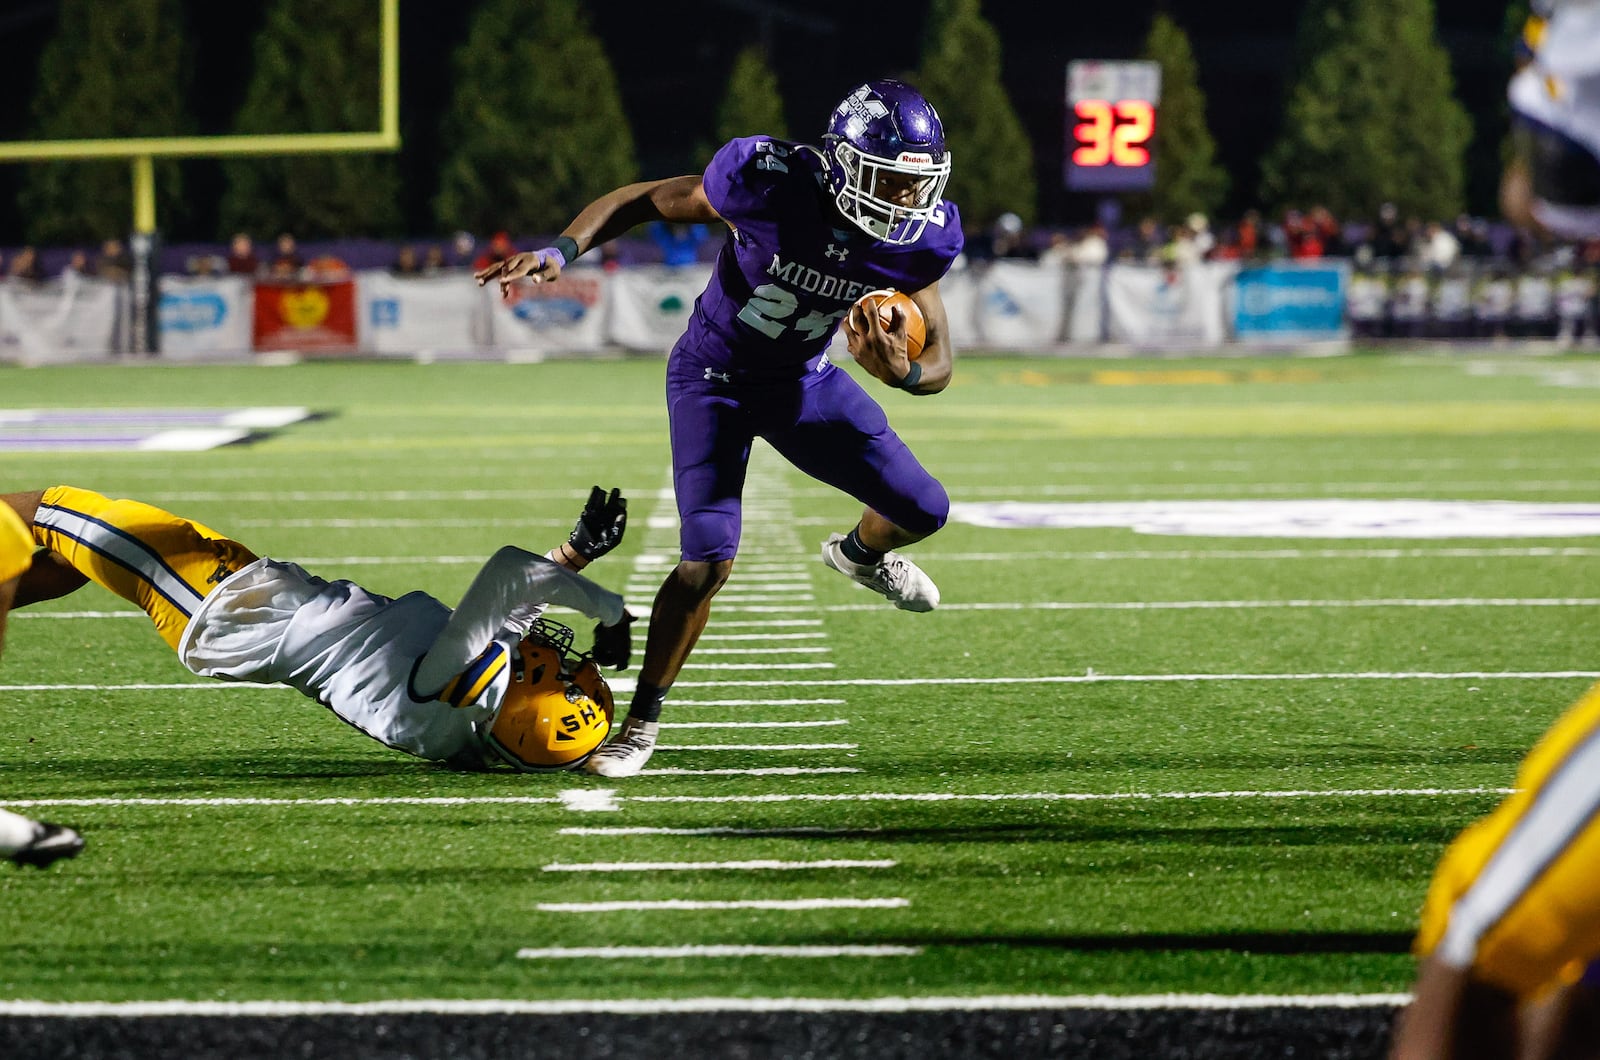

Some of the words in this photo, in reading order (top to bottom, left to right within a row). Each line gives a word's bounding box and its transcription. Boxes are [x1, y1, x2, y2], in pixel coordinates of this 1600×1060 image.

[902, 155, 930, 163] Riddell
[1073, 99, 1154, 167] 32
[737, 283, 848, 342] 24
